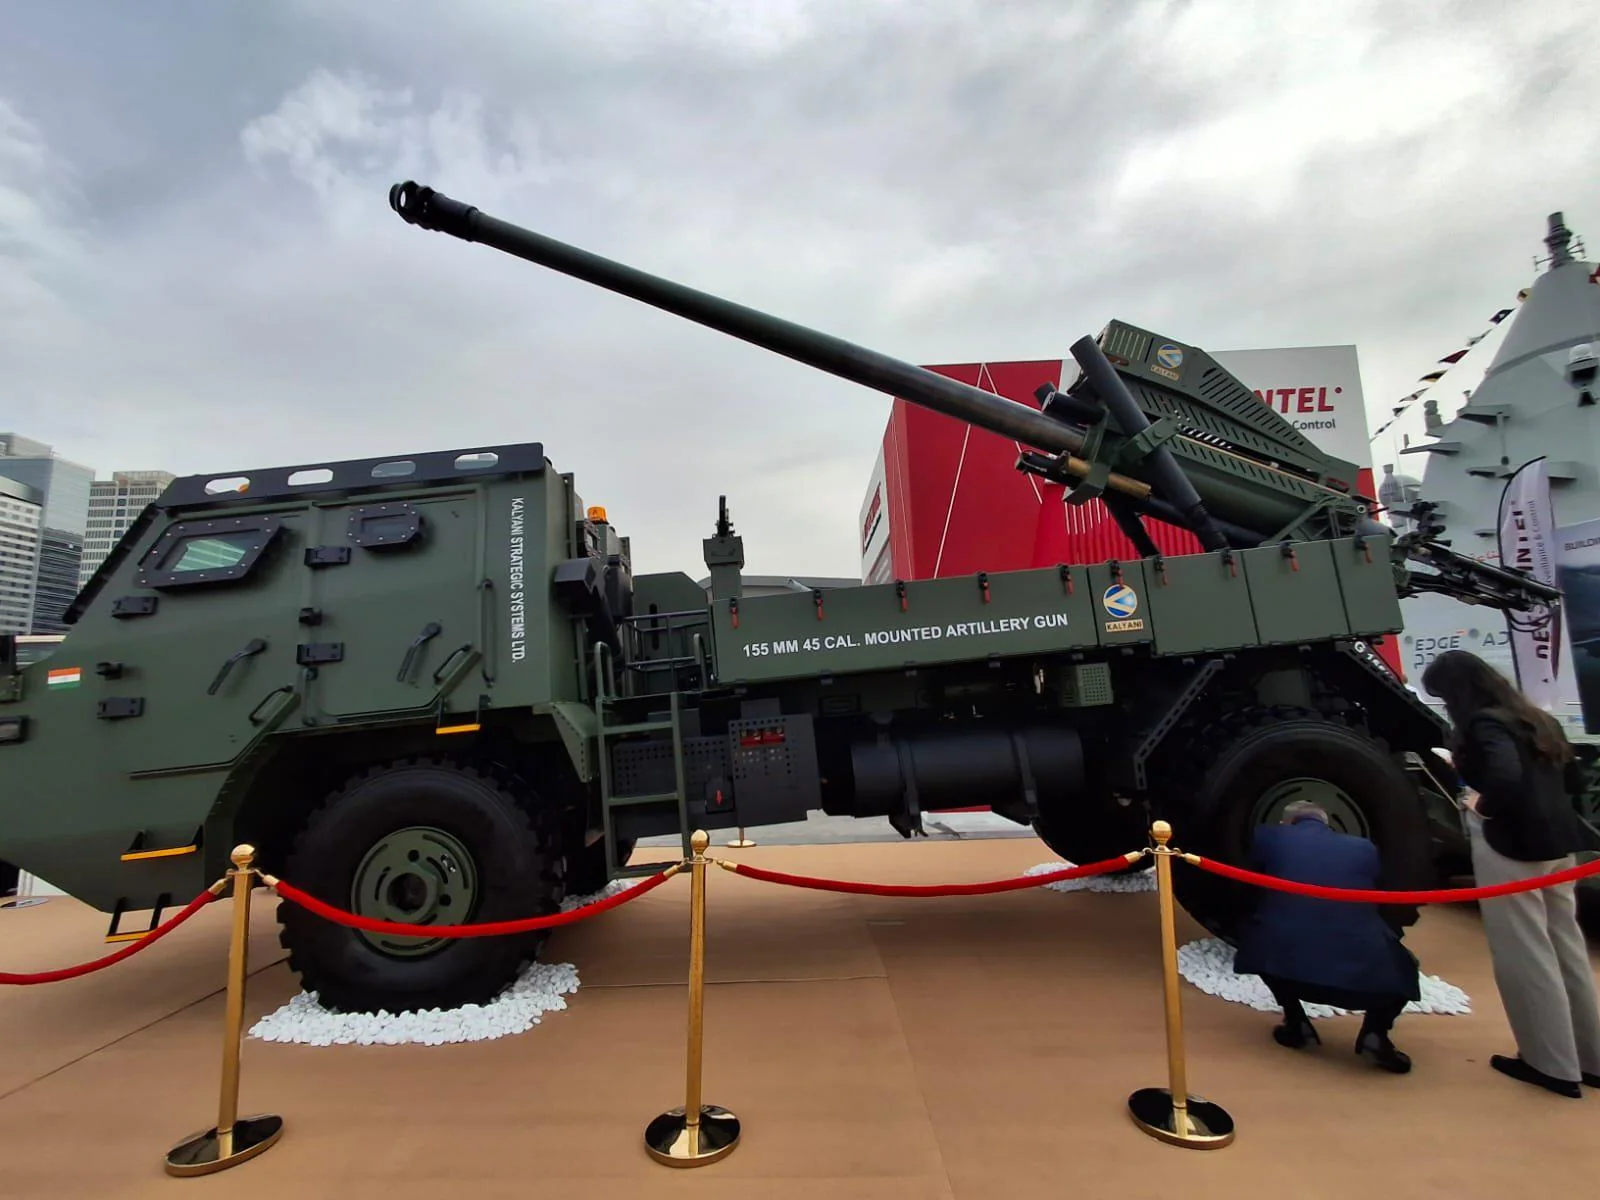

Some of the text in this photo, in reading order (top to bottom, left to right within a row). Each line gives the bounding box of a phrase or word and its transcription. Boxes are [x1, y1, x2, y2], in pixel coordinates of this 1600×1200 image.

[1292, 419, 1336, 430] Control
[510, 497, 526, 663] KALYANI STRATEGIC SYSTEMS LTD.
[1106, 620, 1143, 631] KALYANI
[743, 613, 1068, 657] 155 MM 45 CAL. MOUNTED ARTILLERY GUN
[1415, 635, 1460, 651] EDGE
